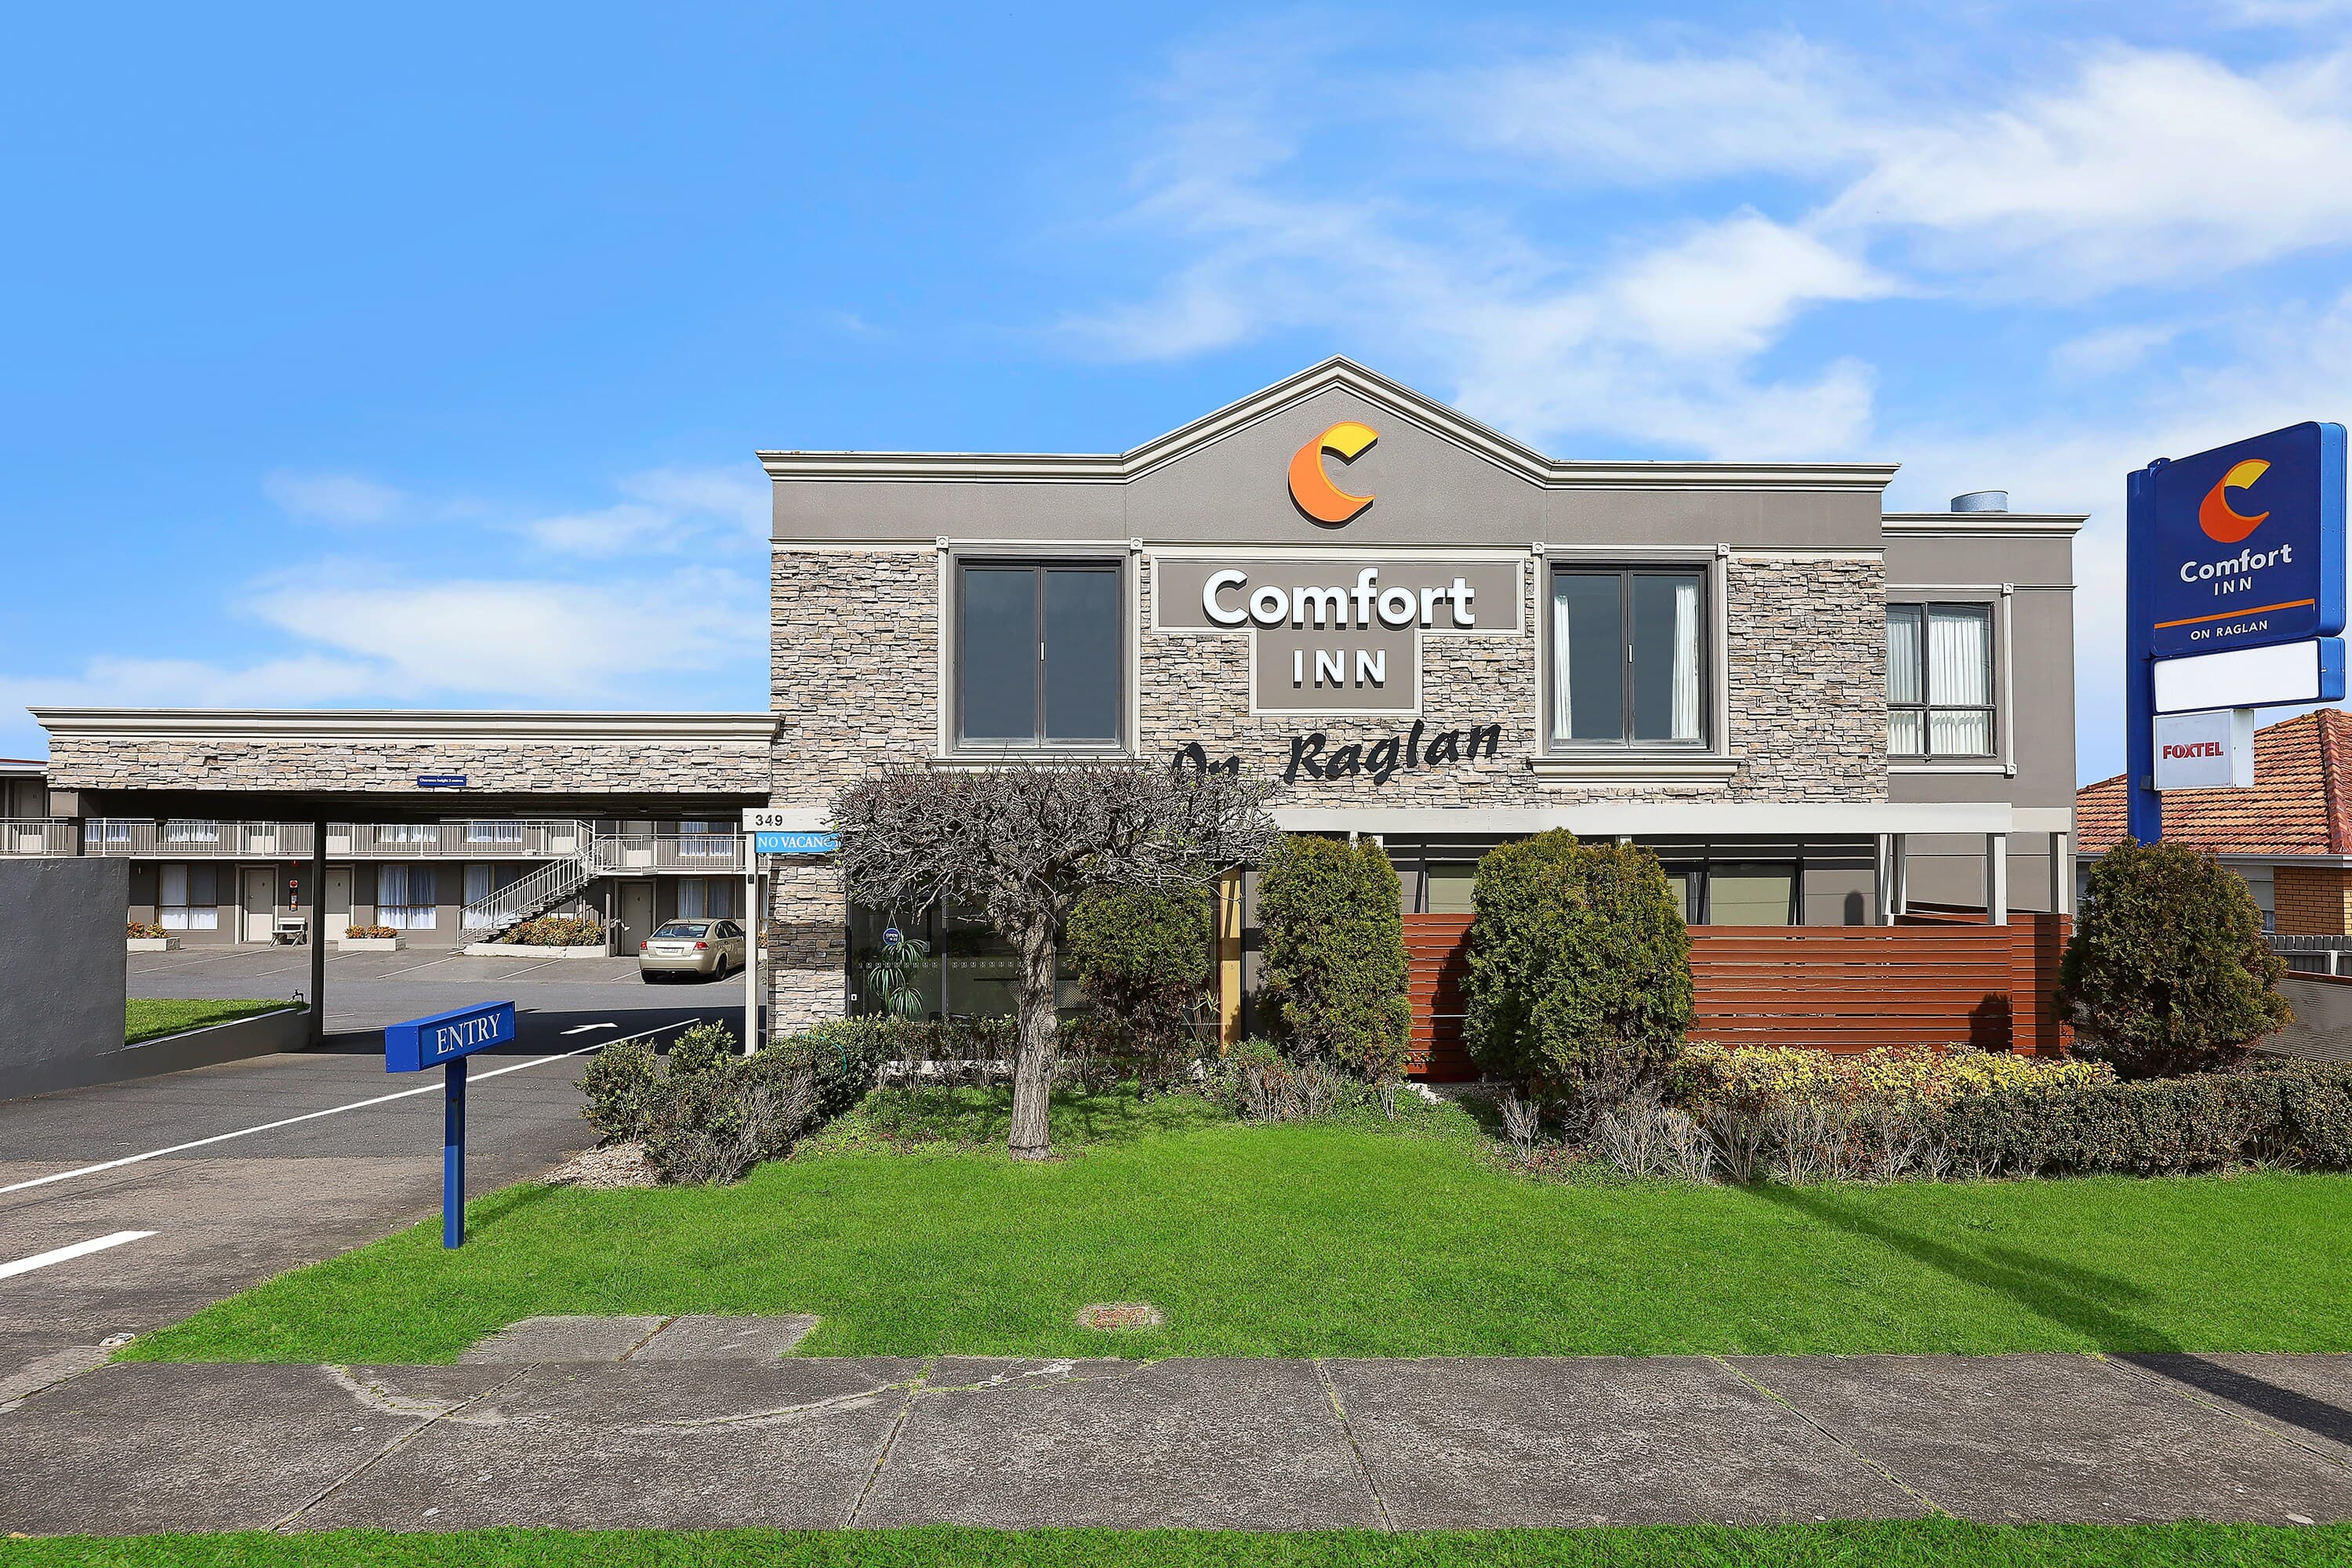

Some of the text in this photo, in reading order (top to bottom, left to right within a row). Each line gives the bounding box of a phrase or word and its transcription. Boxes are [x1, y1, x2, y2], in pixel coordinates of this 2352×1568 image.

[2180, 543, 2292, 583] Comfort
[1202, 567, 1476, 628] Comfort
[2214, 576, 2252, 597] INN
[2190, 619, 2269, 641] ON RAGLAN
[1293, 649, 1386, 688] INN
[1283, 718, 1502, 786] Raglan
[2162, 741, 2224, 760] FOXTEL
[755, 814, 783, 826] 349
[758, 836, 779, 848] NO
[436, 1013, 501, 1055] ENTRY
